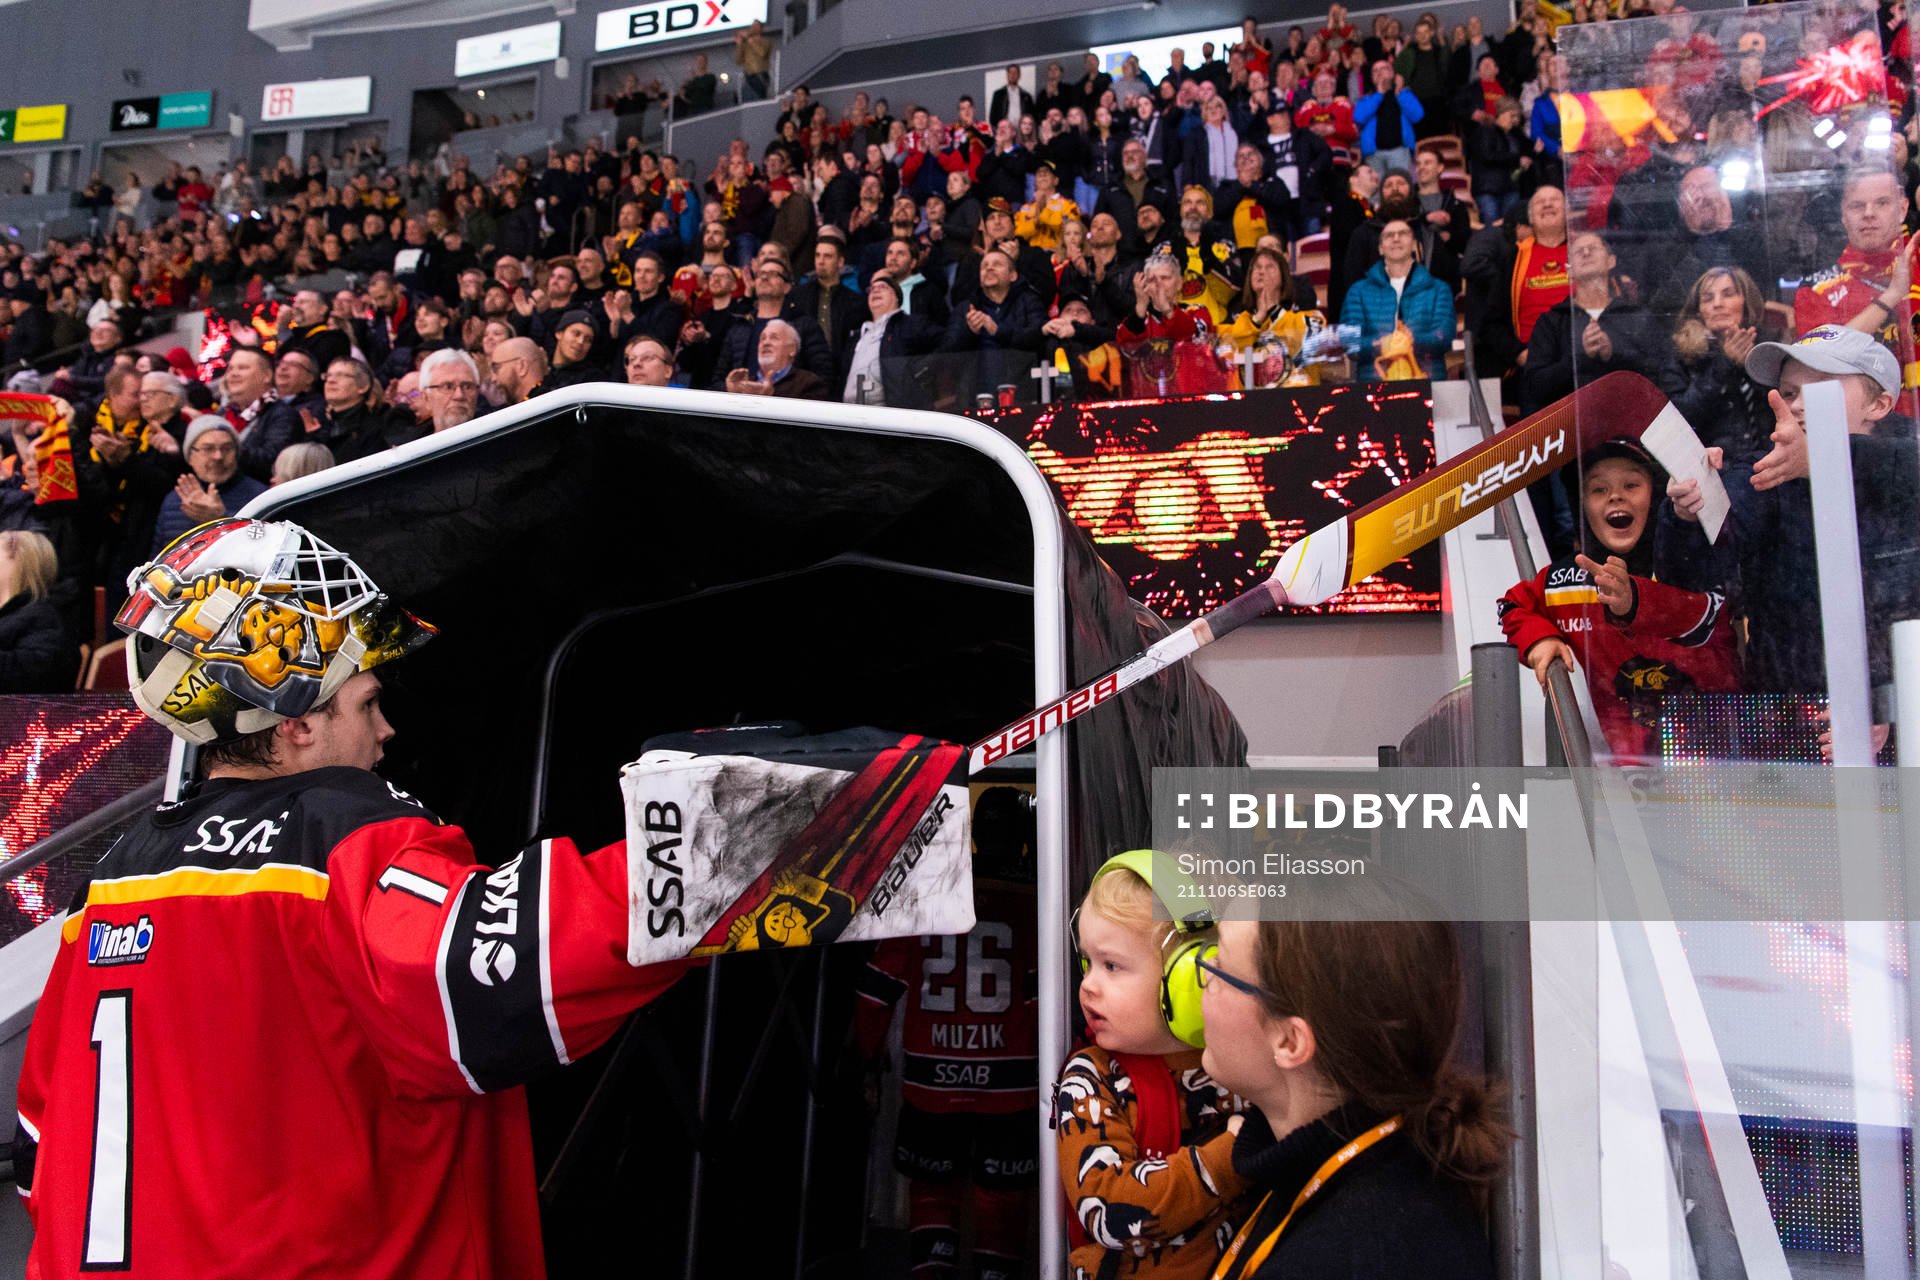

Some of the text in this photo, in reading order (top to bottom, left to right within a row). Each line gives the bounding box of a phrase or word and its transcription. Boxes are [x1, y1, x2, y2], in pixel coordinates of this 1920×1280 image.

[629, 0, 731, 39] BDX
[1392, 429, 1565, 545] HYPERLITE
[1549, 567, 1588, 585] SSAB
[377, 864, 450, 907] 1
[644, 800, 685, 938] SSAB
[88, 917, 154, 964] Vinab
[920, 921, 1013, 1013] 26
[931, 1023, 1005, 1049] MUZIK
[933, 1063, 990, 1085] SSAB
[83, 990, 132, 1270] 1
[1002, 1158, 1040, 1176] LKA
